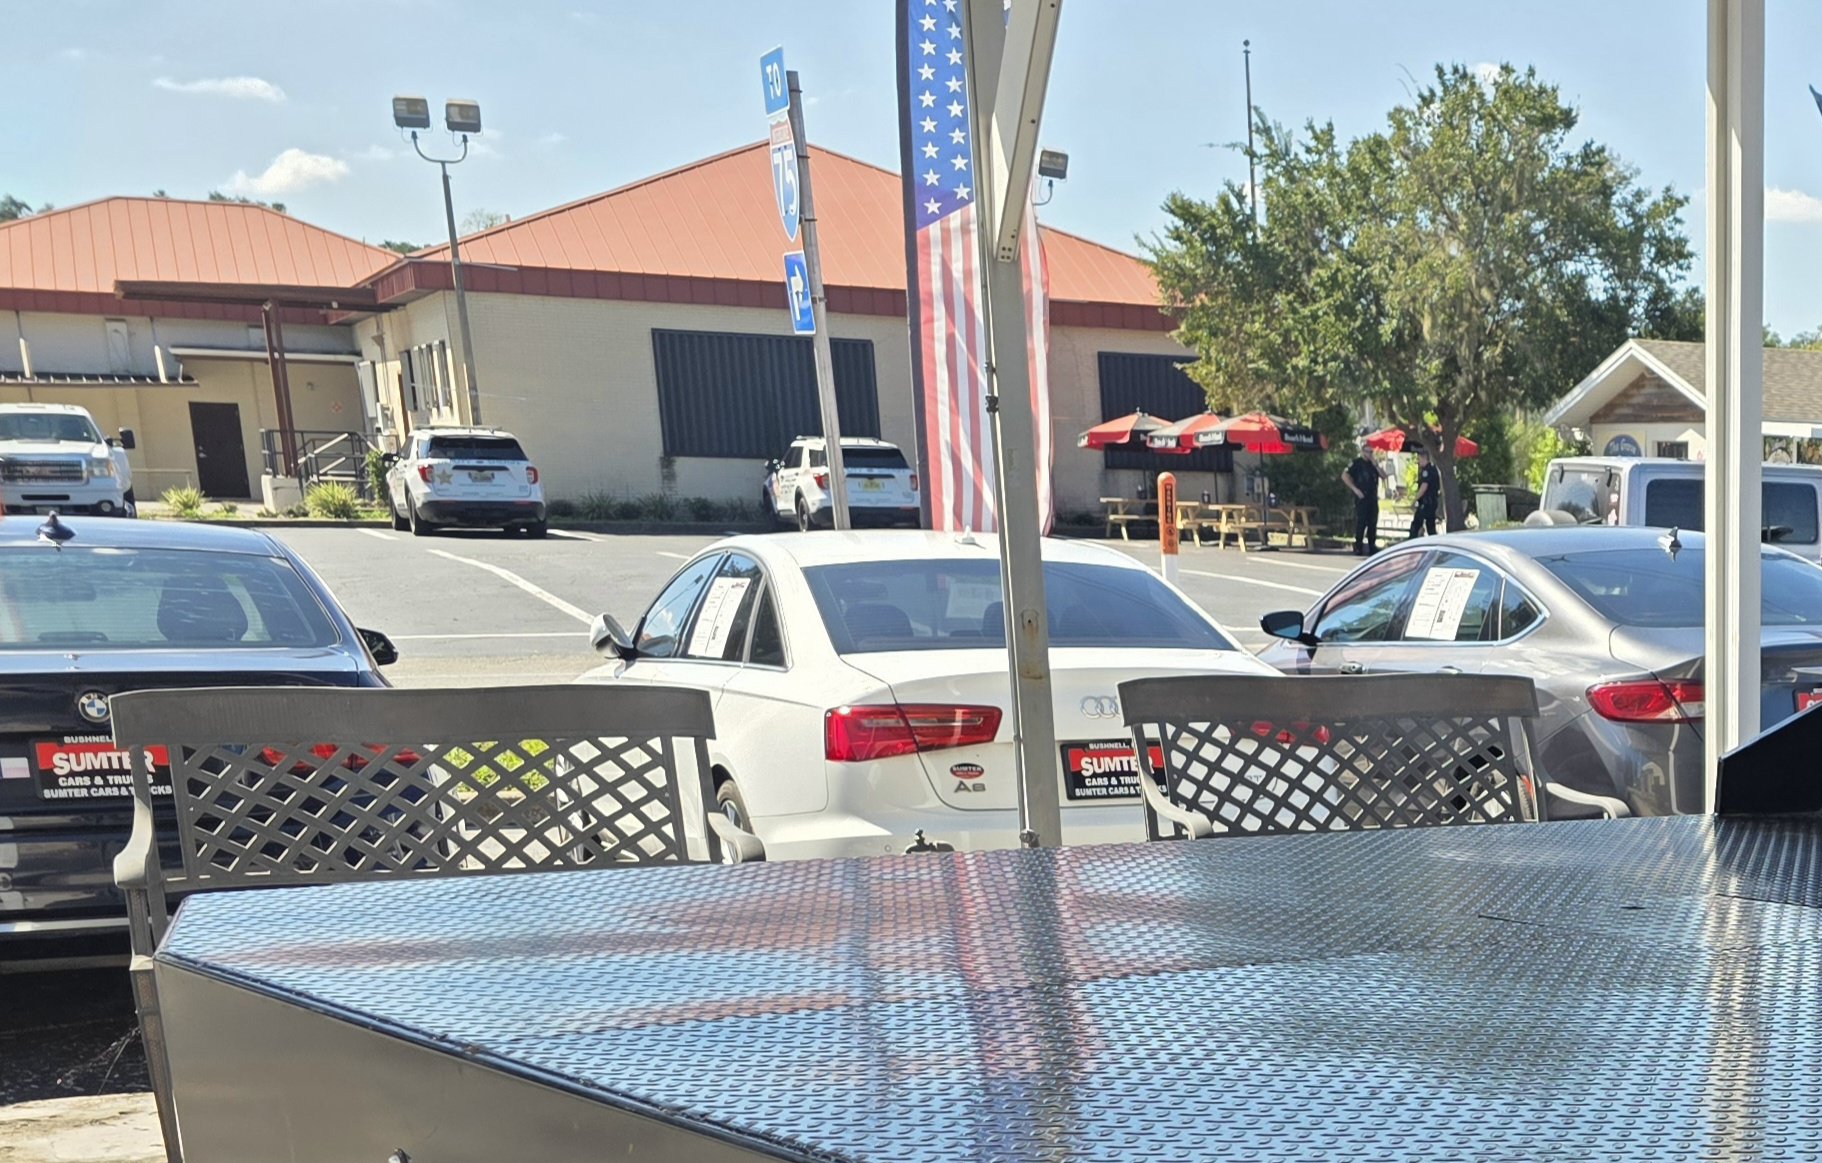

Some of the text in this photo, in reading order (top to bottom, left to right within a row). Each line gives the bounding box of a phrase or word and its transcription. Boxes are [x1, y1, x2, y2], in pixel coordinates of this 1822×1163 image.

[765, 61, 781, 99] TO
[773, 150, 798, 217] 75
[58, 776, 92, 787] CARS
[94, 776, 104, 786] &
[1085, 776, 1109, 787] CARS
[1110, 776, 1118, 785] &
[43, 787, 89, 799] SUMTER
[90, 787, 119, 797] CARS
[120, 788, 129, 796] &
[1075, 787, 1108, 797] SUMTER
[1108, 785, 1129, 796] CARS
